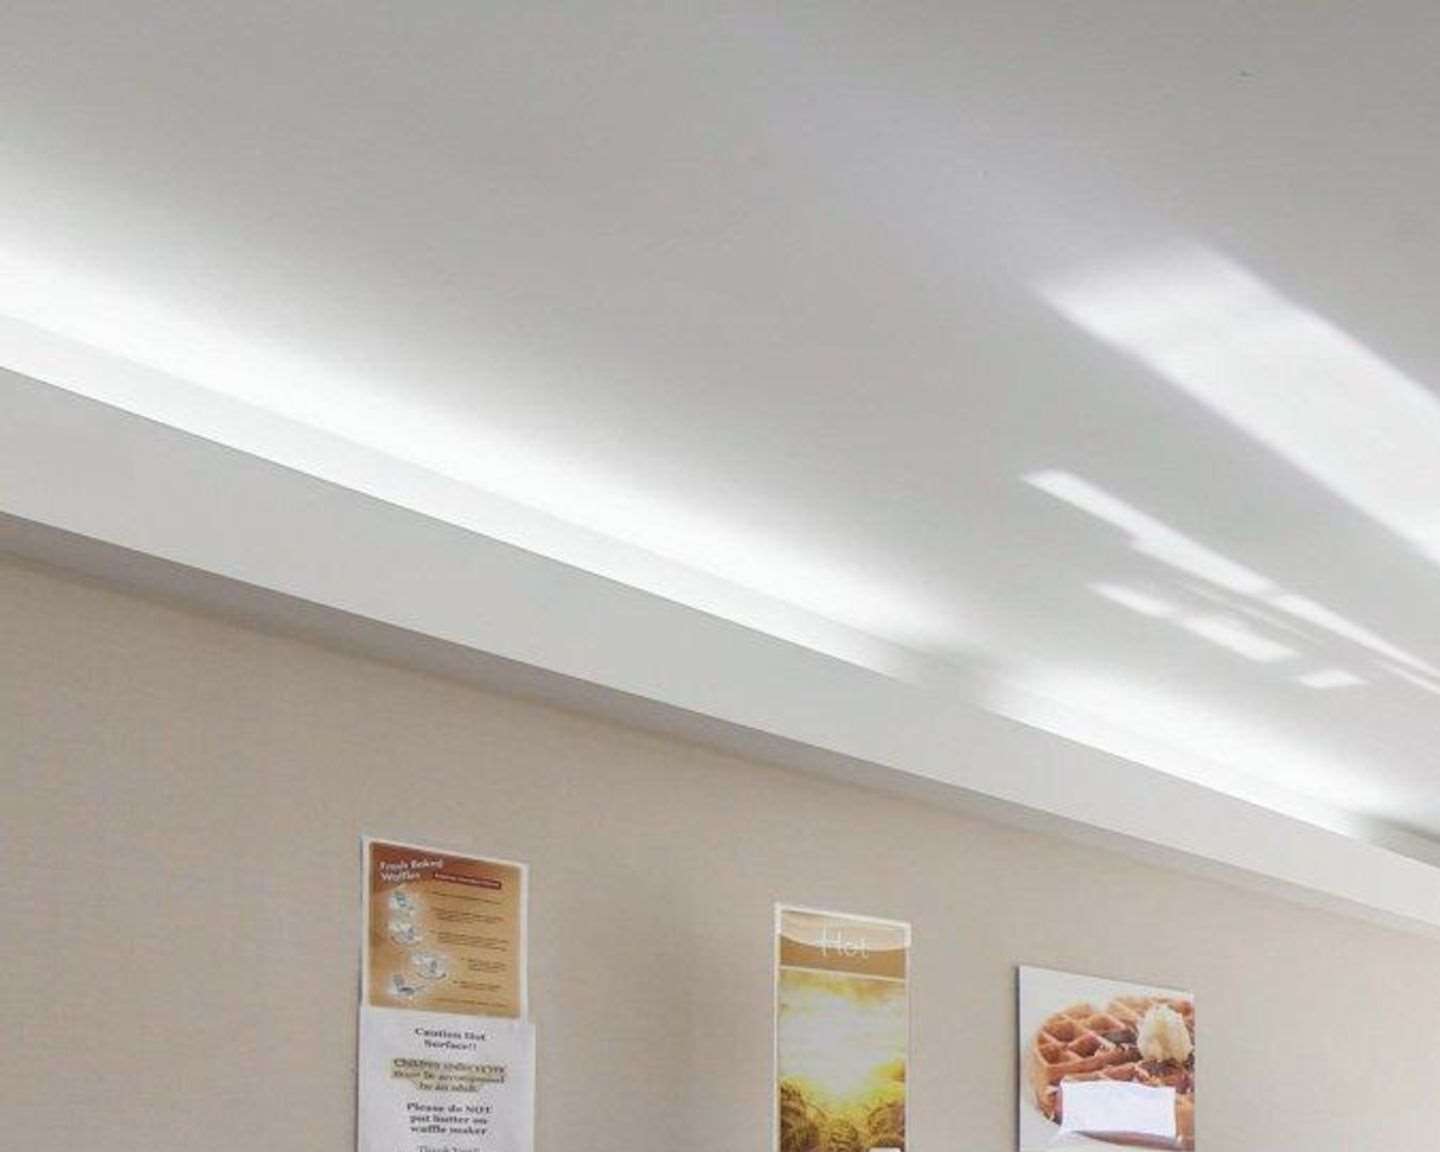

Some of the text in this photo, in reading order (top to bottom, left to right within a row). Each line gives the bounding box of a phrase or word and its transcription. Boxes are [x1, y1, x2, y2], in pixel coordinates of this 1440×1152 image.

[815, 926, 869, 958] Hot
[415, 1028, 487, 1041] Caution Hot
[407, 1102, 493, 1114] Please do NOT
[409, 1115, 430, 1124] put
[433, 1115, 469, 1124] butter
[410, 1125, 487, 1136] waffle maker
